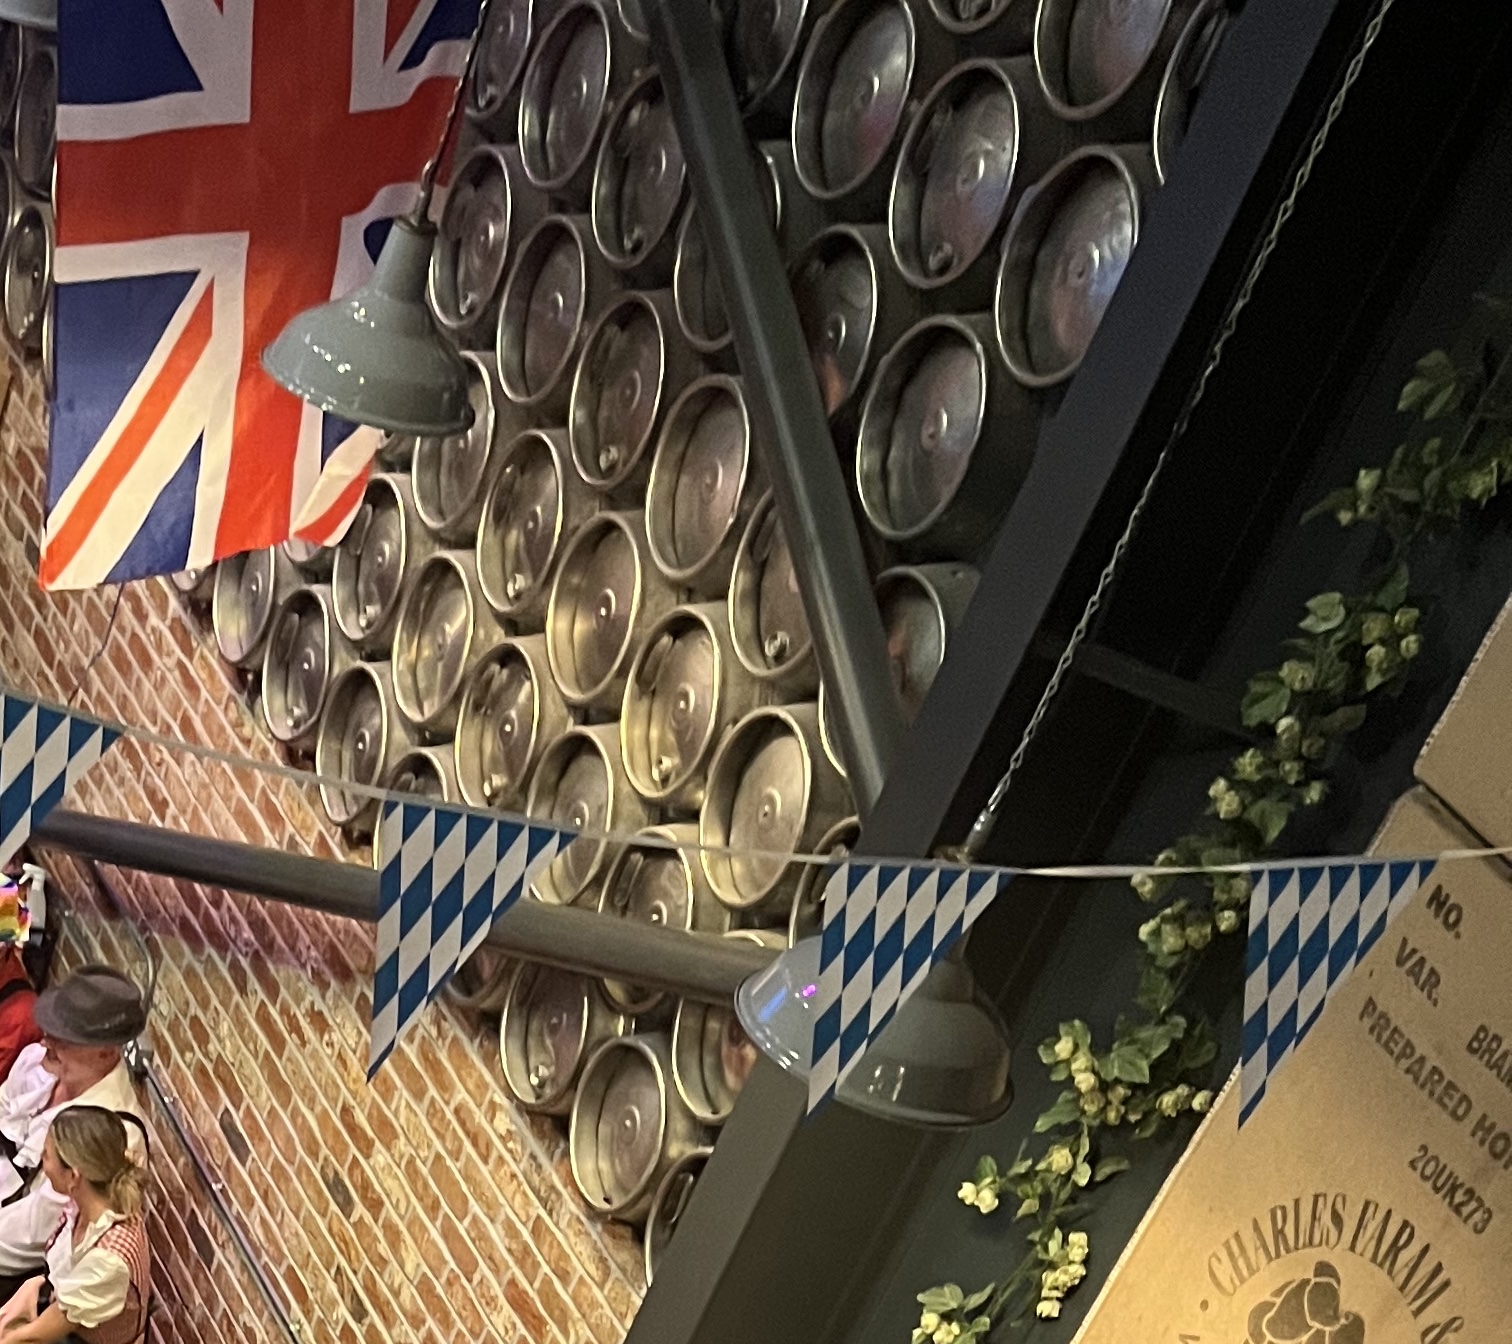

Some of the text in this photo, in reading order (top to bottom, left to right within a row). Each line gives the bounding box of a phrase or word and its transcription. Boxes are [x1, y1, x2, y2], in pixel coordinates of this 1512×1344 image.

[1426, 884, 1464, 939] NO.
[1395, 937, 1442, 1007] VAR.
[1359, 996, 1473, 1122] PREPARED
[1408, 1144, 1494, 1235] 20UK273
[1207, 1191, 1347, 1297] CHARLES
[1347, 1199, 1452, 1319] FARAM
